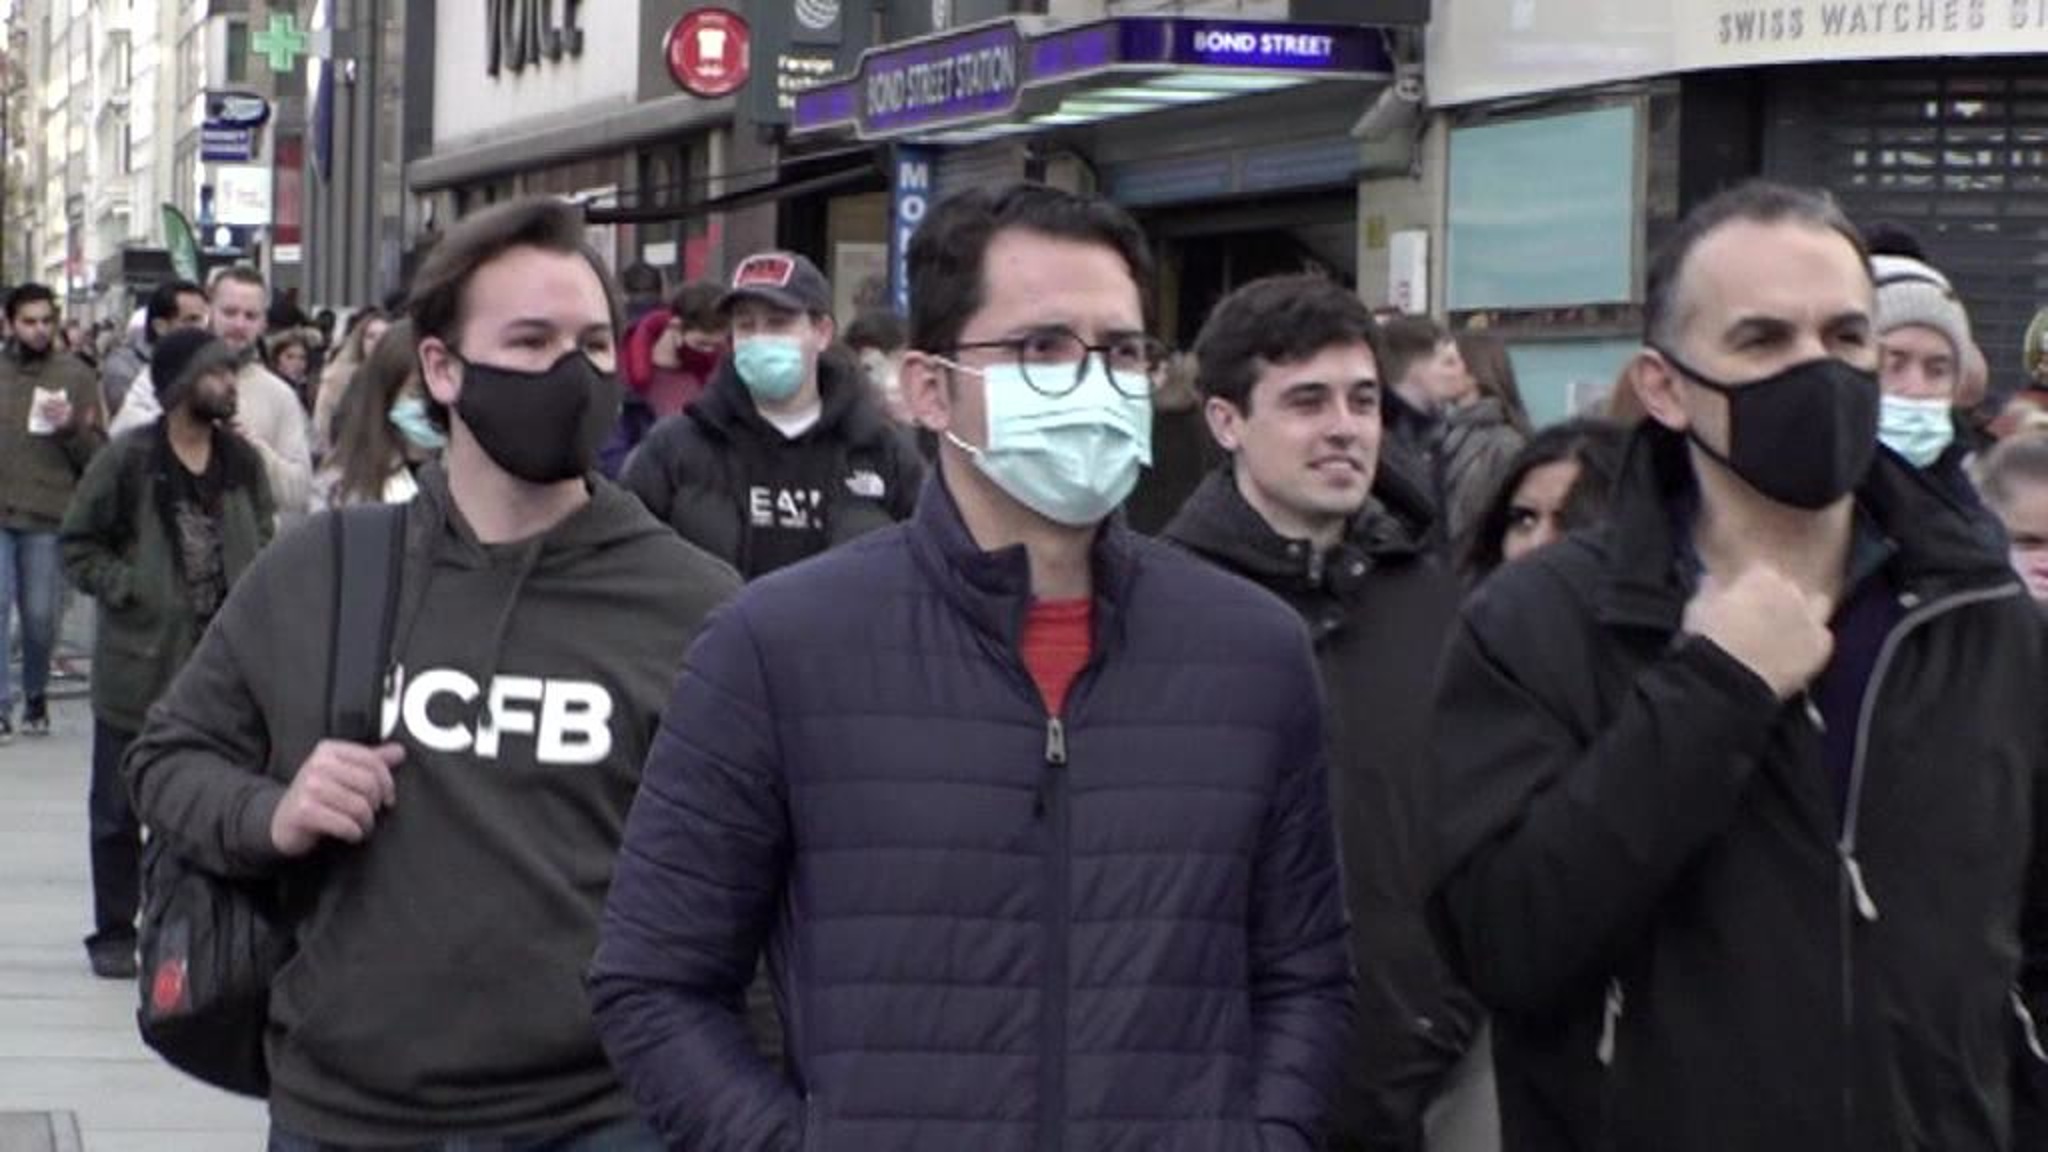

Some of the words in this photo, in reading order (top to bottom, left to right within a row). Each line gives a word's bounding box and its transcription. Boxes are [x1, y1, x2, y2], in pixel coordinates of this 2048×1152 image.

[1194, 31, 1257, 53] BOND
[1260, 33, 1333, 57] STREET
[1719, 9, 1804, 44] SWISS
[1821, 0, 1985, 36] WATCHES
[868, 70, 905, 117] BOND
[907, 57, 954, 109] STREET
[956, 45, 1017, 99] STATION
